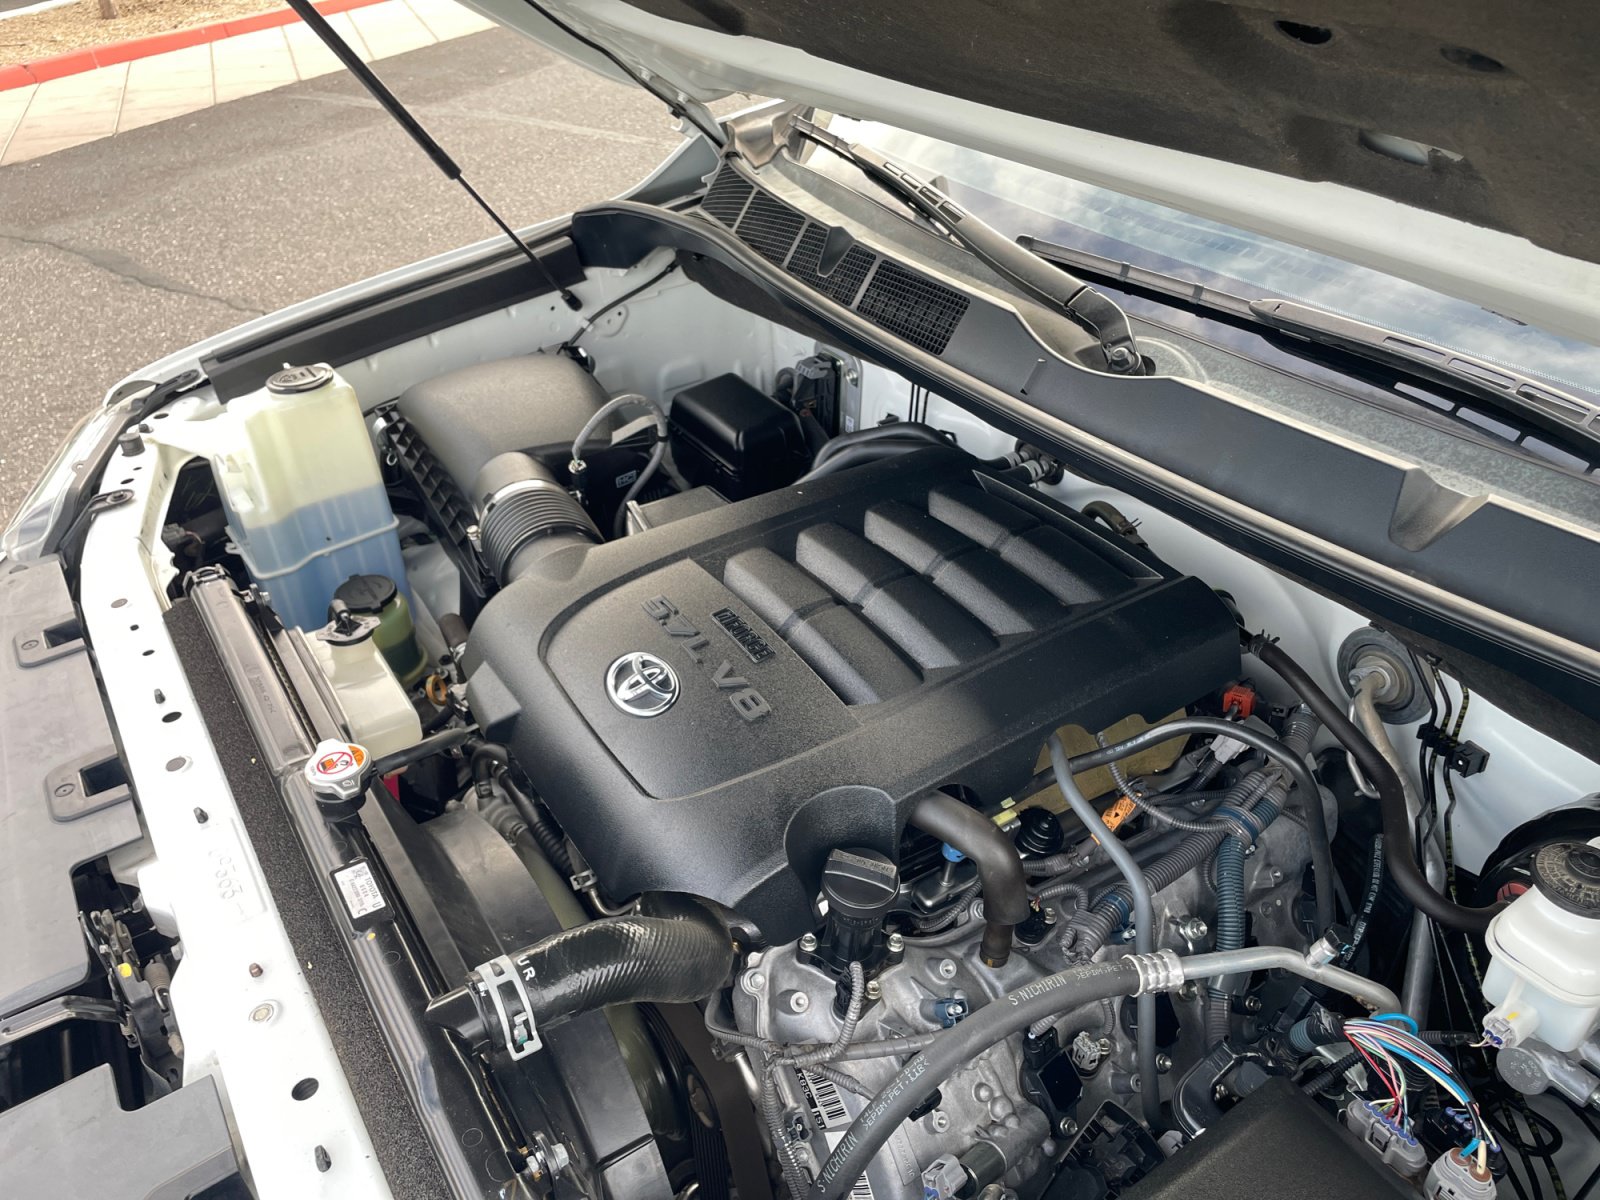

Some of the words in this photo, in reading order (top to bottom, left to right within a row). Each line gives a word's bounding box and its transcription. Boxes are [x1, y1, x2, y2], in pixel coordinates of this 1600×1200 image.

[641, 595, 709, 664] 5.7L
[711, 660, 771, 720] V8
[365, 876, 379, 899] TOYOTA
[517, 956, 535, 981] UR
